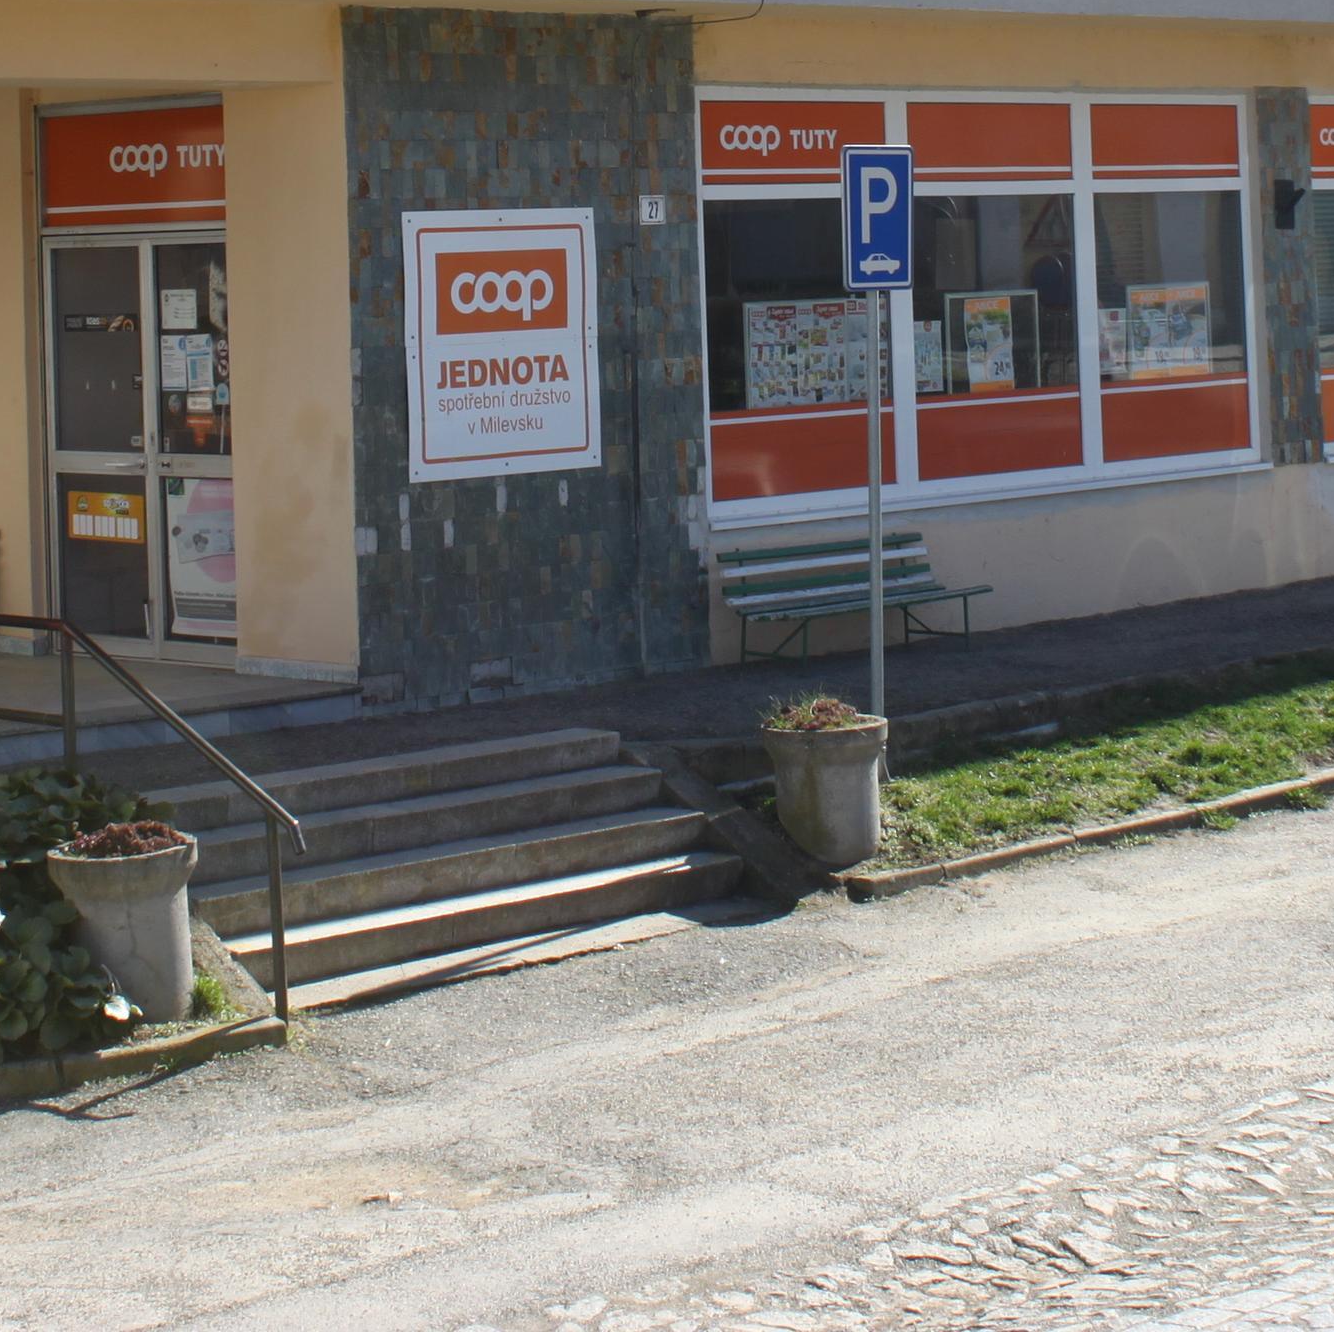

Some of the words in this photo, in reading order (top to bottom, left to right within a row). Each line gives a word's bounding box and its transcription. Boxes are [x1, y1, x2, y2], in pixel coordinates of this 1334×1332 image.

[720, 124, 781, 156] coop
[789, 129, 838, 150] TUTY
[109, 143, 168, 178] coop
[176, 144, 225, 168] TUTY
[648, 201, 658, 219] 27
[860, 167, 898, 244] P
[451, 269, 554, 321] coop
[437, 354, 569, 390] JEDNOTA
[438, 391, 505, 415] spotřební
[510, 388, 571, 407] družstvo
[468, 421, 476, 435] v
[480, 414, 543, 434] Milevsku
